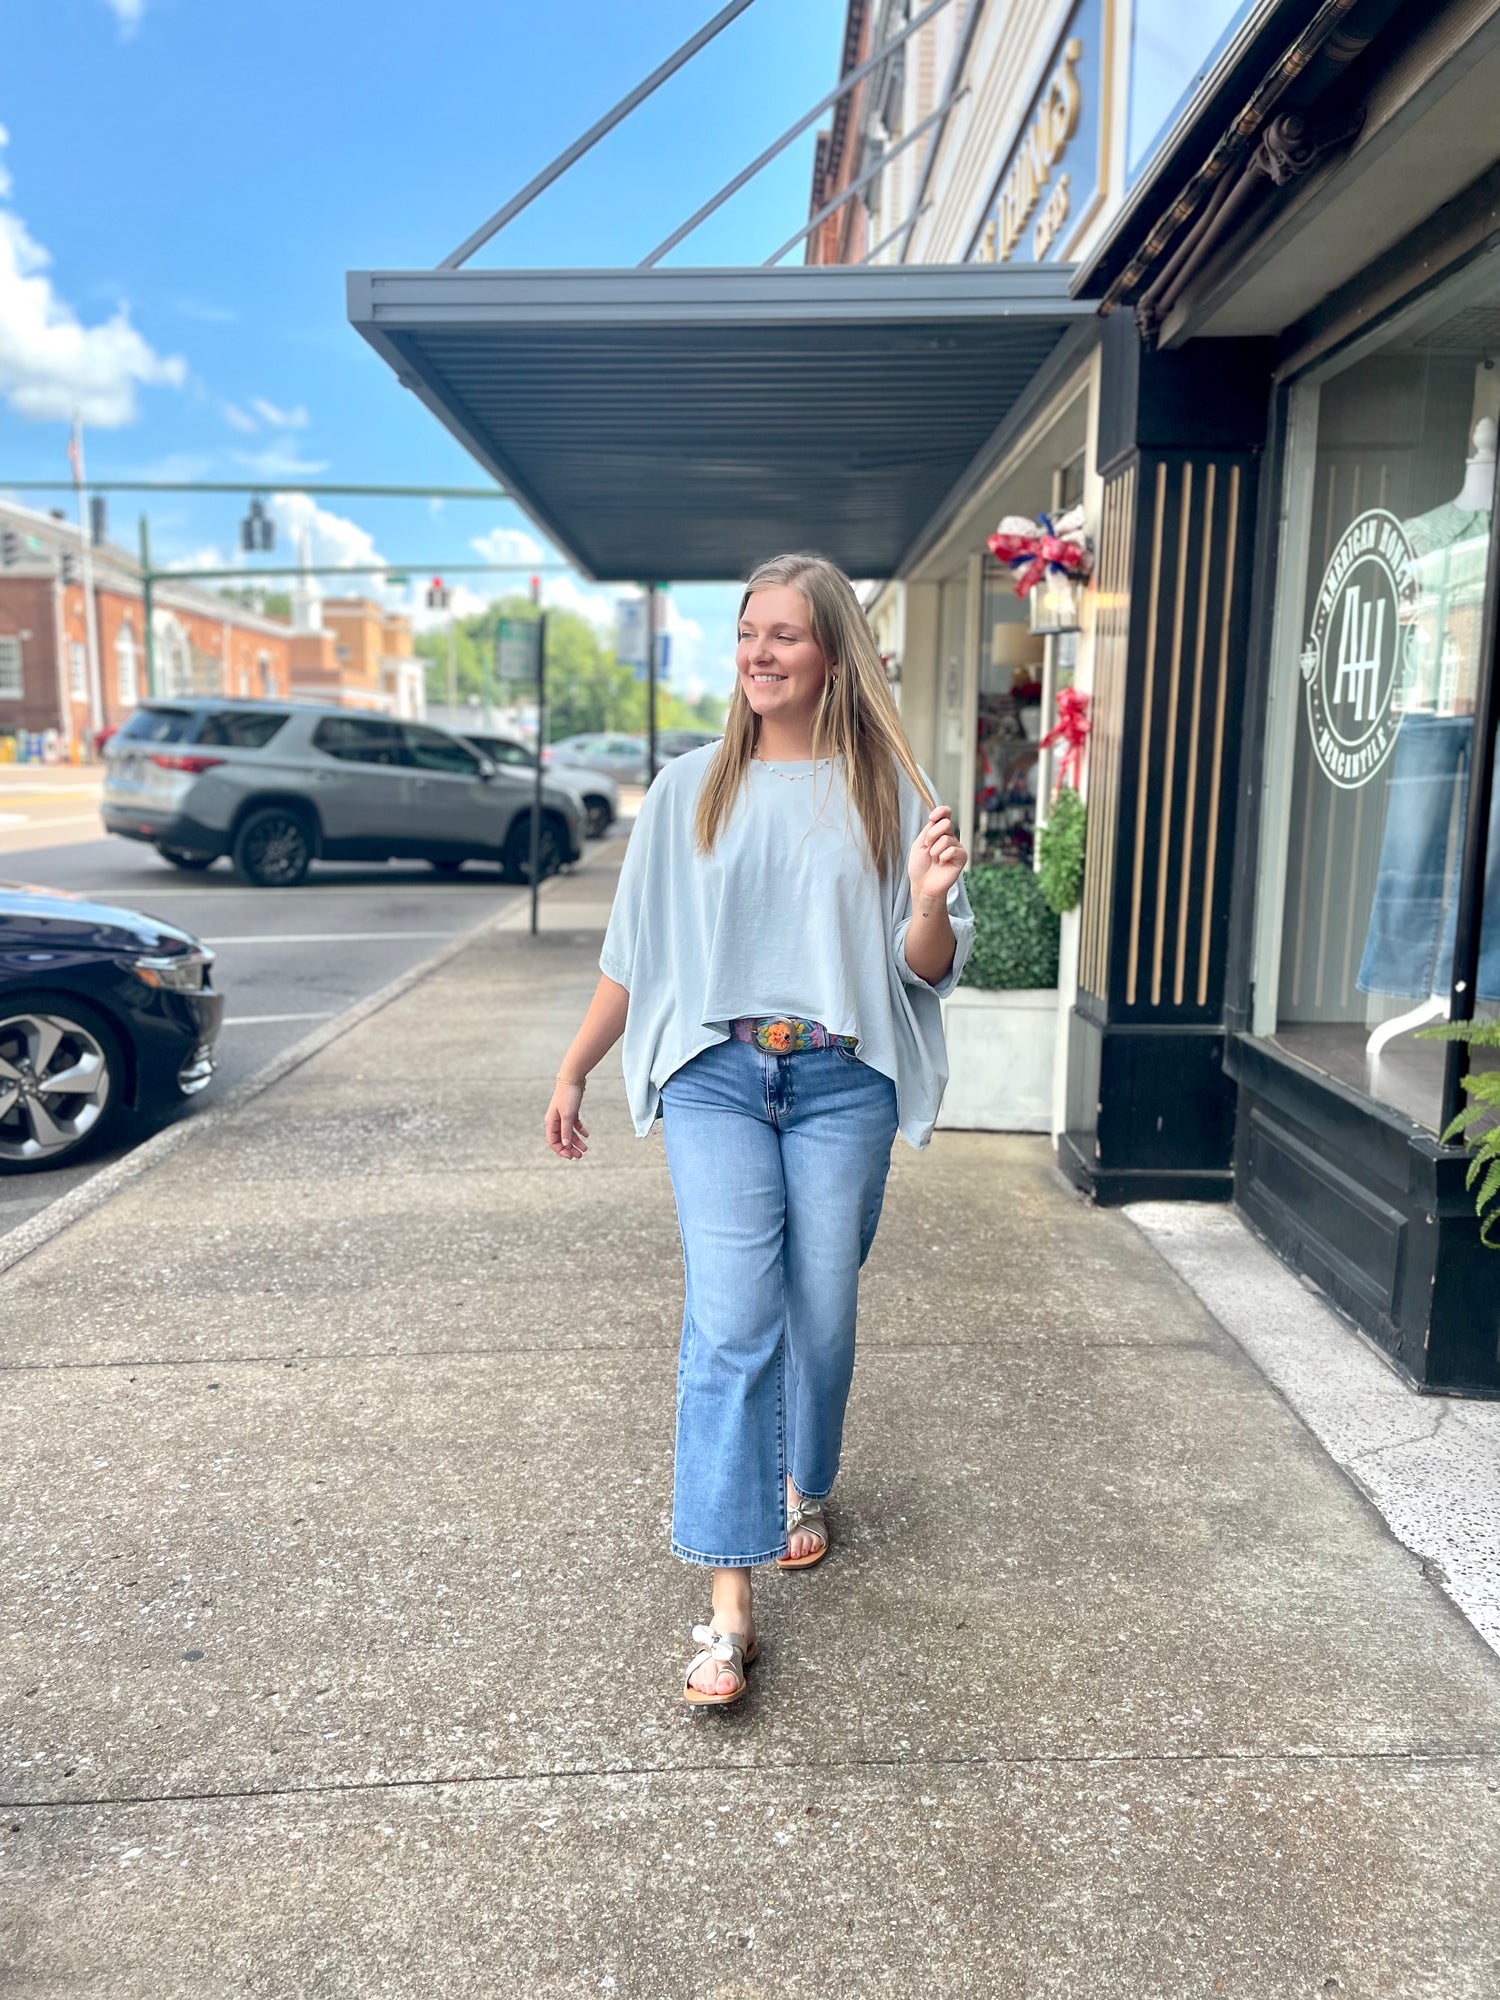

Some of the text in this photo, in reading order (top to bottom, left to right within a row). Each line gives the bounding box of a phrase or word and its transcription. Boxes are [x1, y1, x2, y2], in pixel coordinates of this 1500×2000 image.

[1321, 519, 1414, 613] AMERICAN HONEY
[1332, 584, 1386, 721] AH
[1318, 726, 1388, 778] MERCANTILE
